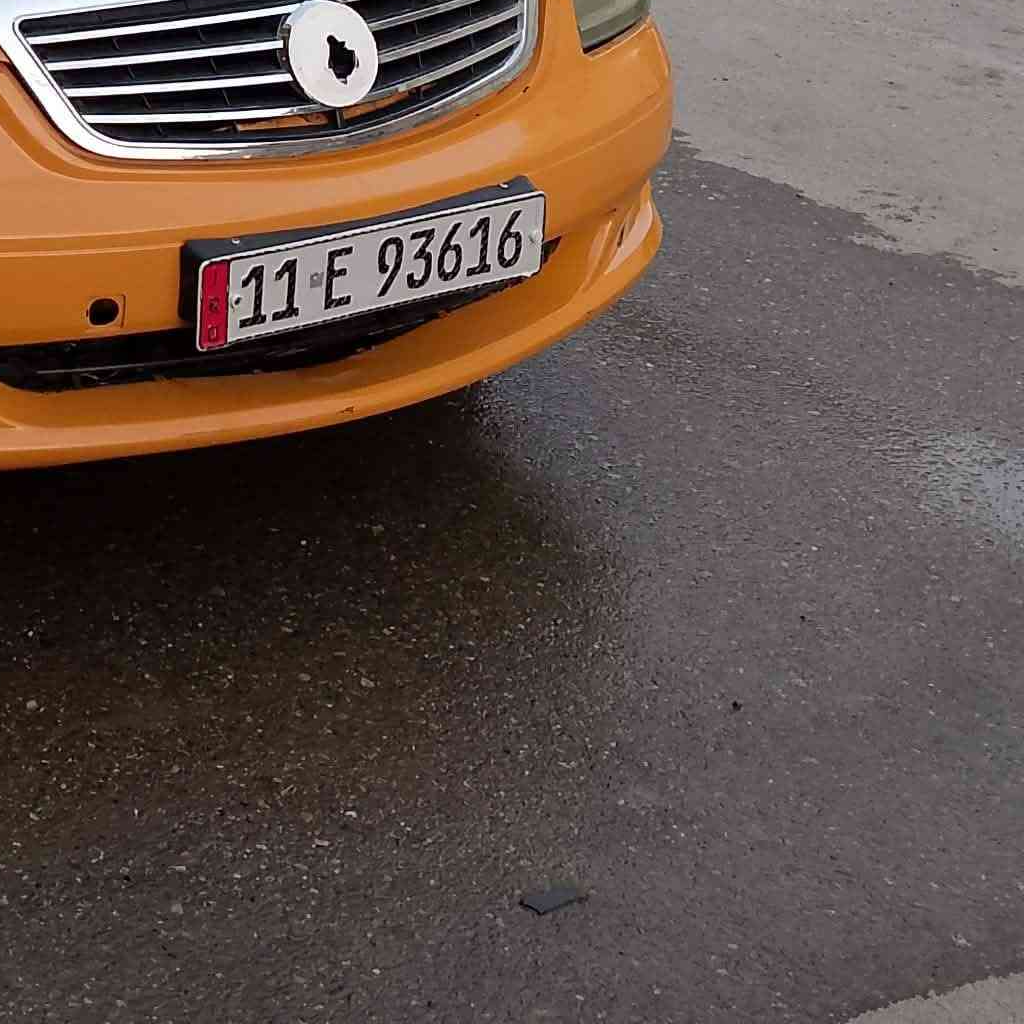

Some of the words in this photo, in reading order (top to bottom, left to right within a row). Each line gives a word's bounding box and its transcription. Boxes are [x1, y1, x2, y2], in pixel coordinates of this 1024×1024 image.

[239, 259, 299, 328] 11
[323, 246, 353, 310] E
[376, 209, 522, 298] 93616
